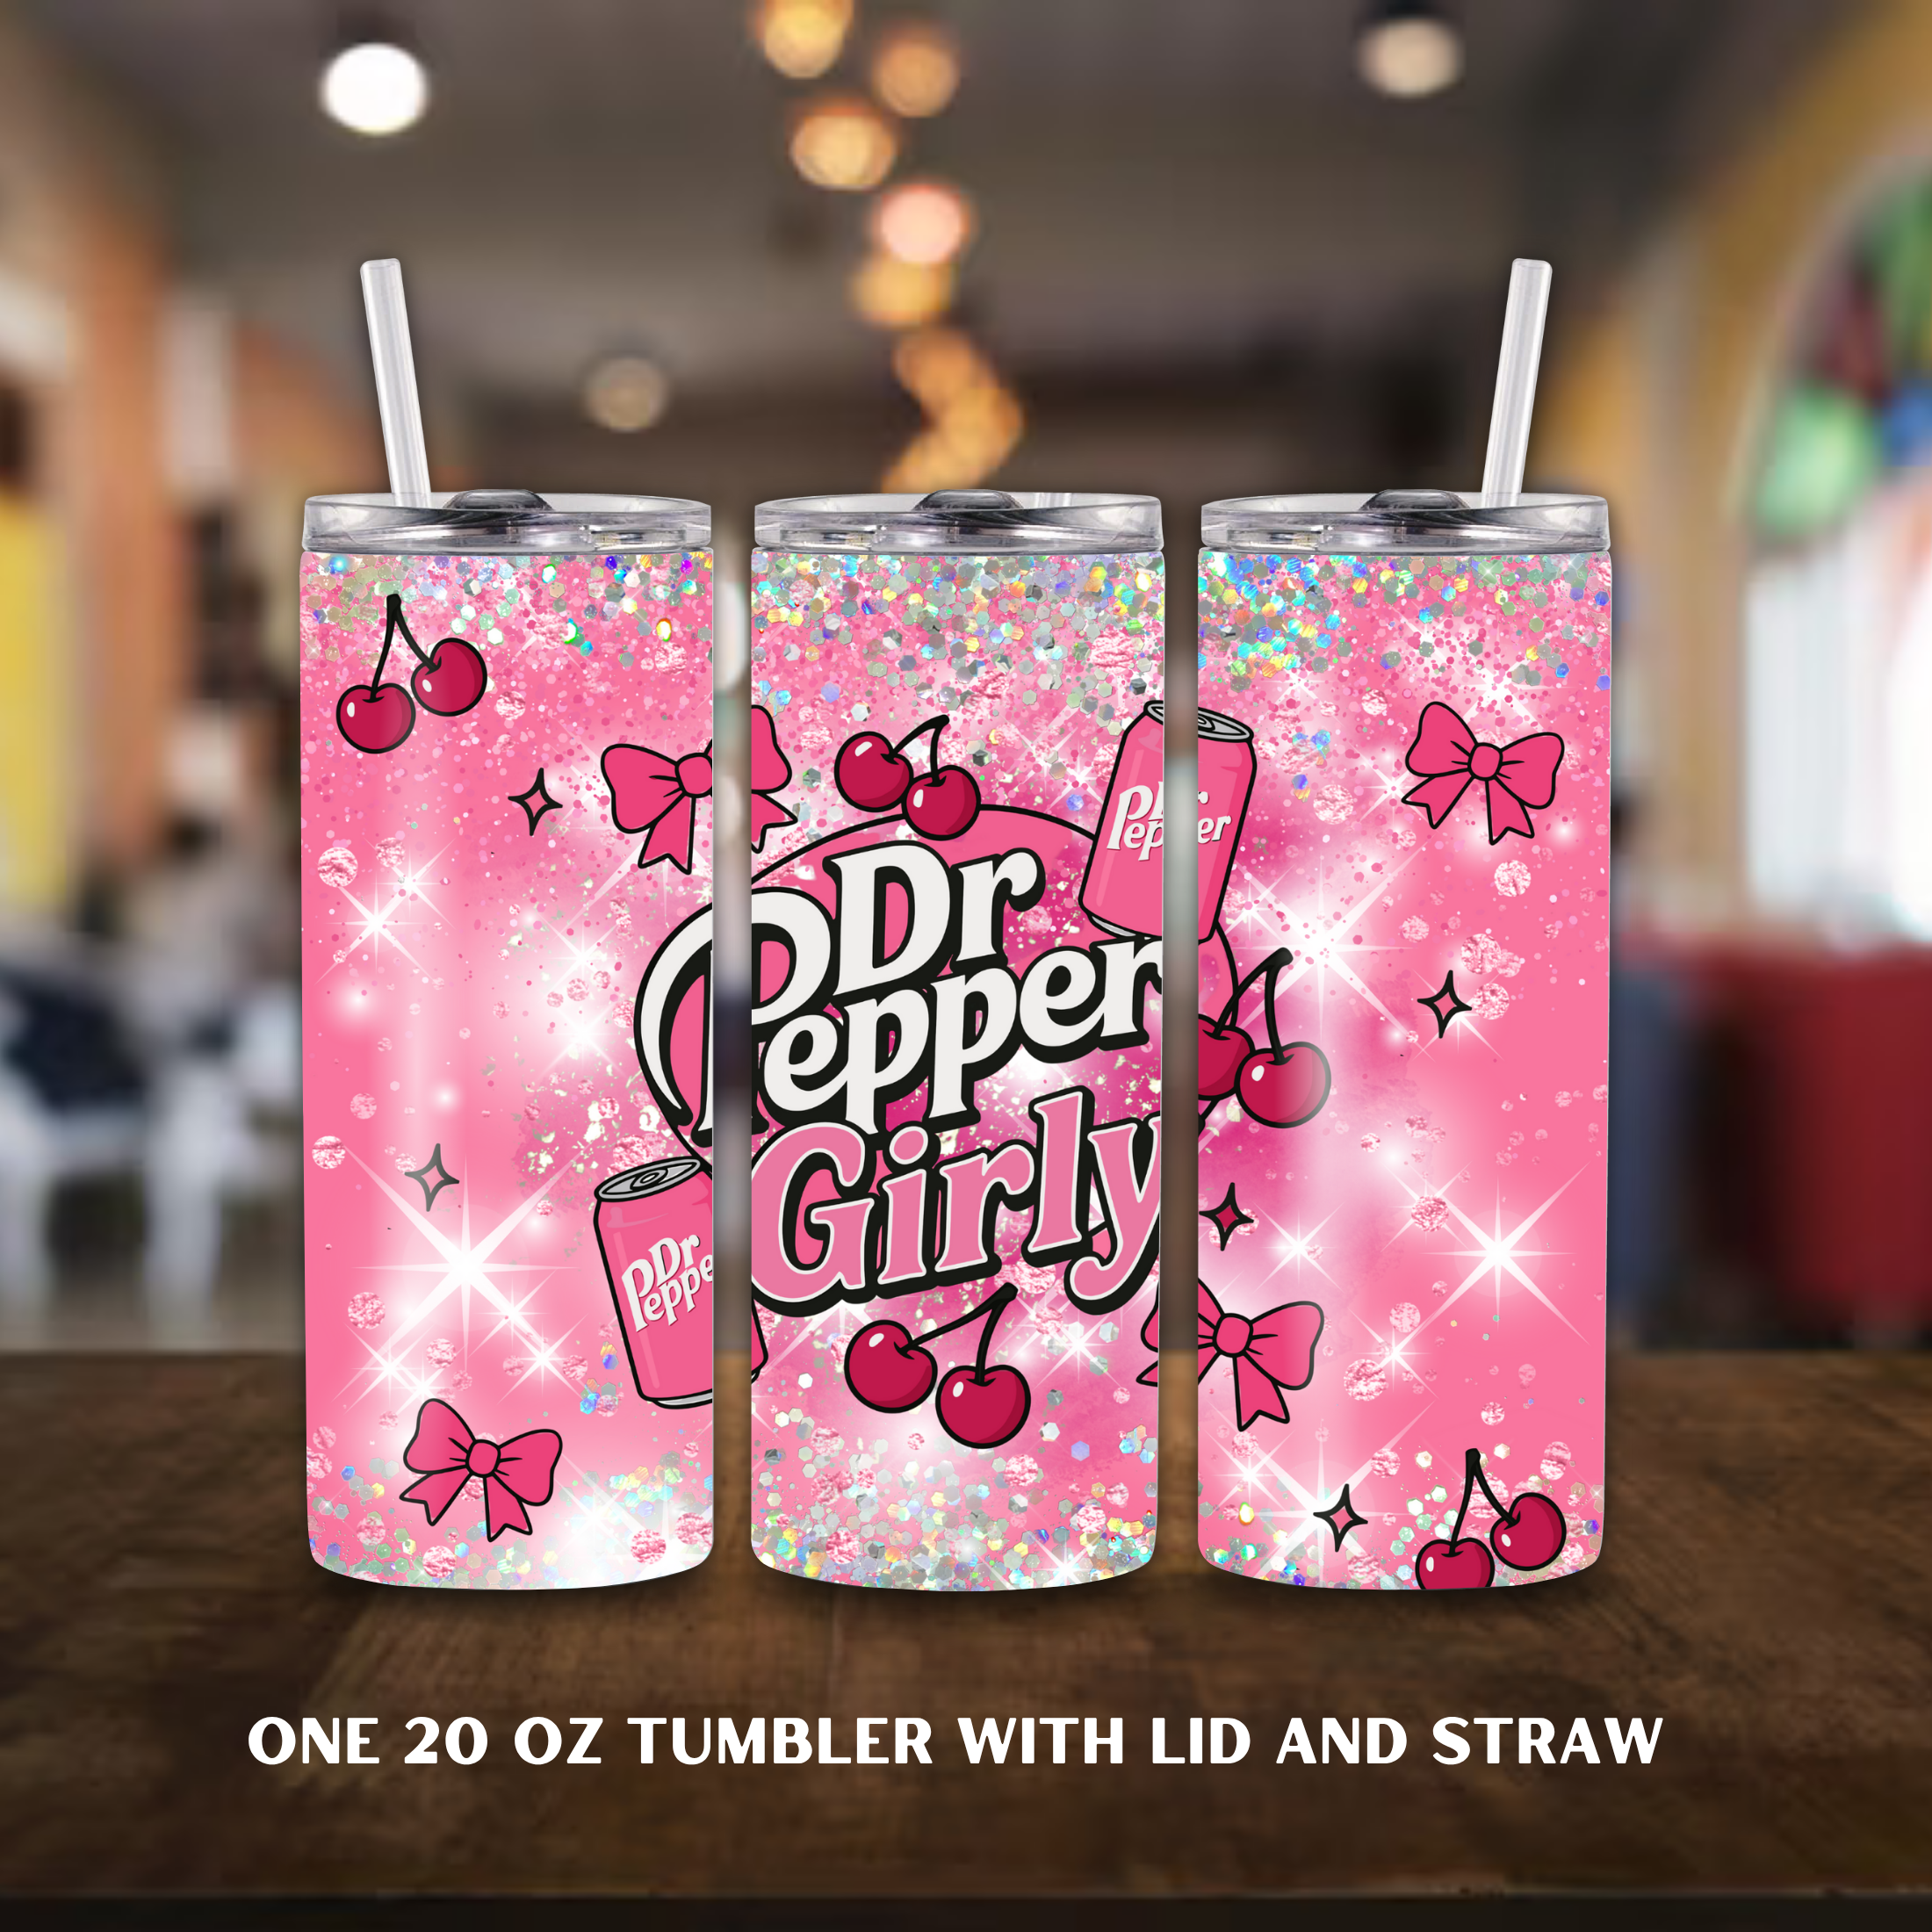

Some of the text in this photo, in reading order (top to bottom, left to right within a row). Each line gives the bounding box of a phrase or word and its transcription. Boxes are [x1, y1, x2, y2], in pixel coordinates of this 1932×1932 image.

[829, 843, 1038, 996] Dr
[752, 1091, 1162, 1301] Girly
[621, 1254, 713, 1332] Peppe
[648, 1234, 701, 1287] Dr
